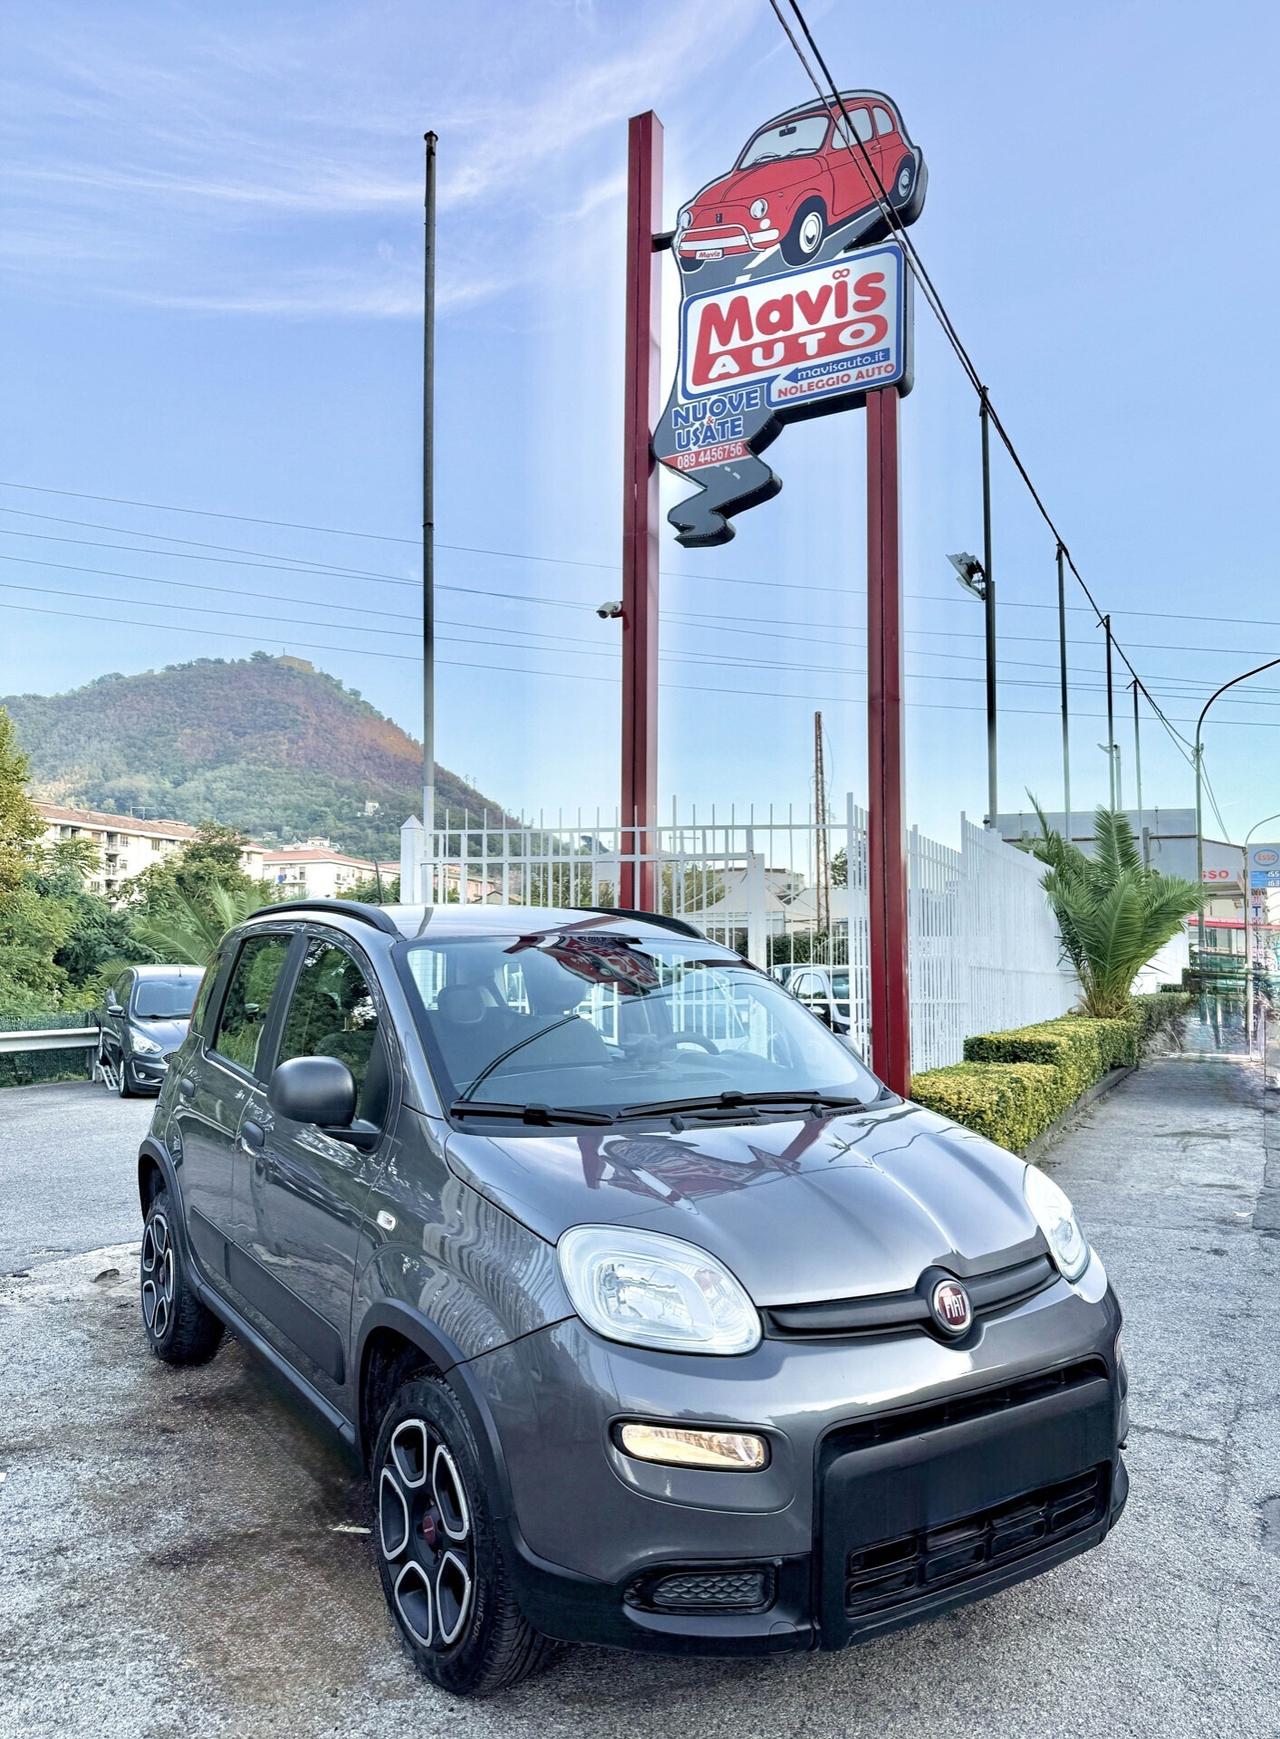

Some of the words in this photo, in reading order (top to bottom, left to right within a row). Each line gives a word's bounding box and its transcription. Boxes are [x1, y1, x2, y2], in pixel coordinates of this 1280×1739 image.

[708, 322, 876, 379] AUTO
[797, 351, 885, 379] mavisauto.it
[777, 373, 852, 399] NOLEGGIO
[855, 363, 895, 381] AUTO
[672, 387, 760, 428] NUOVE
[676, 415, 744, 450] USATE
[677, 453, 696, 469] 089
[698, 442, 743, 464] 4456756
[943, 1294, 965, 1318] FIAT
